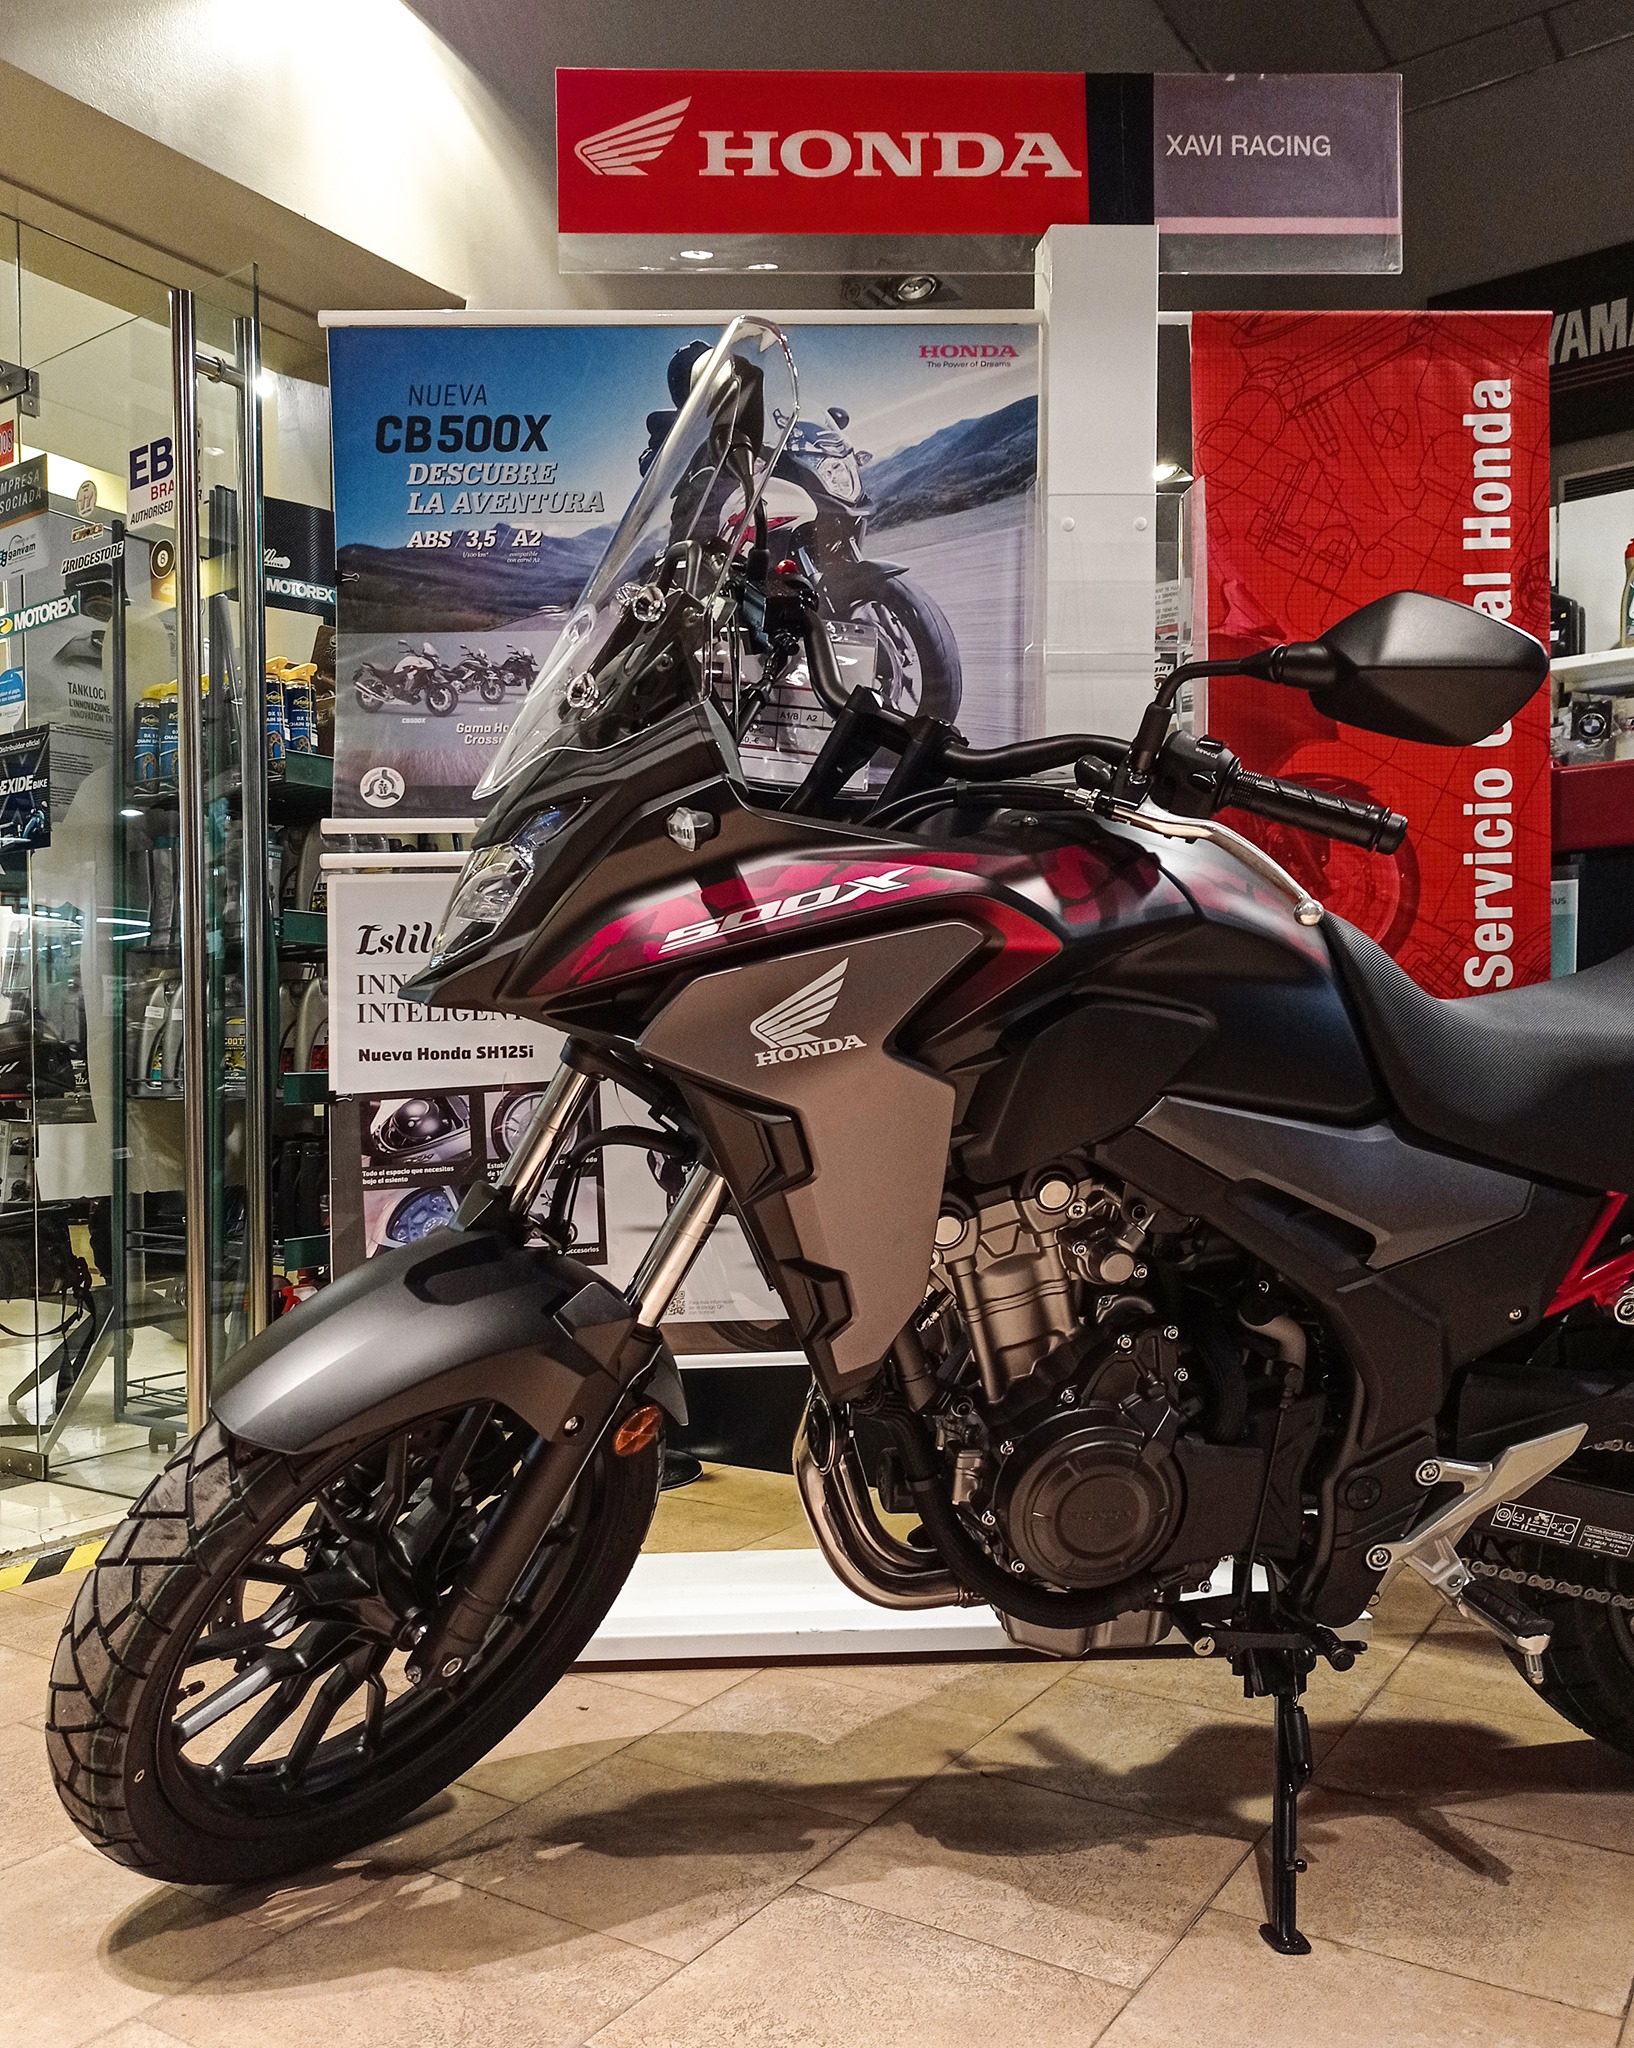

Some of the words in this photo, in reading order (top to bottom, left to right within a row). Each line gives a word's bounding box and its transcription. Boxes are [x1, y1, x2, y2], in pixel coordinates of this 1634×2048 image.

[698, 130, 1083, 178] HONDA
[1165, 134, 1222, 157] XAVI
[1231, 134, 1332, 157] RACING
[1548, 299, 1634, 366] YAM
[919, 344, 1019, 358] HONDA
[943, 361, 968, 369] Power
[408, 384, 488, 406] NUEVA
[375, 414, 552, 454] CB500X
[406, 462, 558, 486] DESCUBRE
[1463, 379, 1512, 550] Honda
[130, 500, 174, 525] AUTHORISED
[406, 492, 446, 515] LA
[450, 491, 605, 514] AVENTURA
[406, 530, 453, 549] ABS
[465, 530, 497, 550] 3,5
[511, 530, 543, 547] A2
[62, 543, 122, 573] BRIDGESTONE
[267, 578, 334, 602] MOTOREX
[14, 595, 76, 631] MOTOREX
[456, 723, 491, 733] Gama
[780, 712, 798, 720] A1/B
[33, 779, 47, 790] BIKE
[1463, 767, 1514, 988] Servicio
[658, 867, 913, 954] 500X
[358, 1049, 412, 1062] Nueva
[417, 1047, 471, 1060] Honda
[476, 1045, 534, 1059] SH125i
[755, 1034, 866, 1066] HONDA
